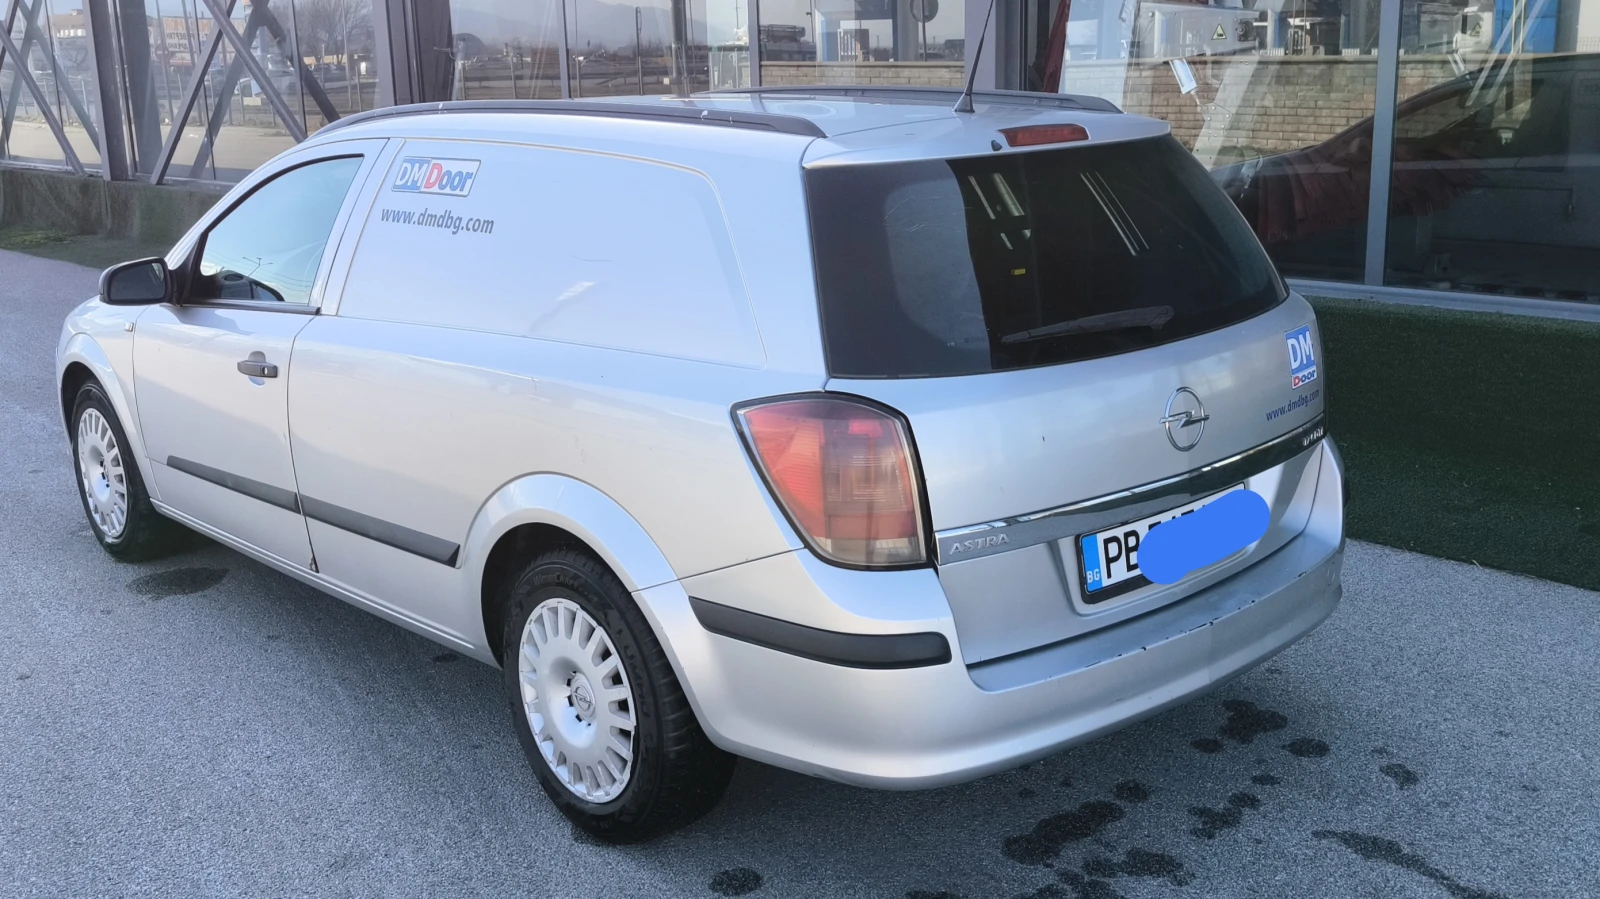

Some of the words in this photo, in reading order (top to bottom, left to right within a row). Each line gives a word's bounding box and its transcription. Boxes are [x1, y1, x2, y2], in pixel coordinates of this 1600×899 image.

[381, 208, 494, 235] www.dmdbg.com
[1287, 331, 1315, 370] DM
[1293, 370, 1316, 387] Door
[1266, 389, 1320, 421] www.dmdbg.com
[949, 533, 1010, 555] ASTRA
[1086, 568, 1101, 584] BG
